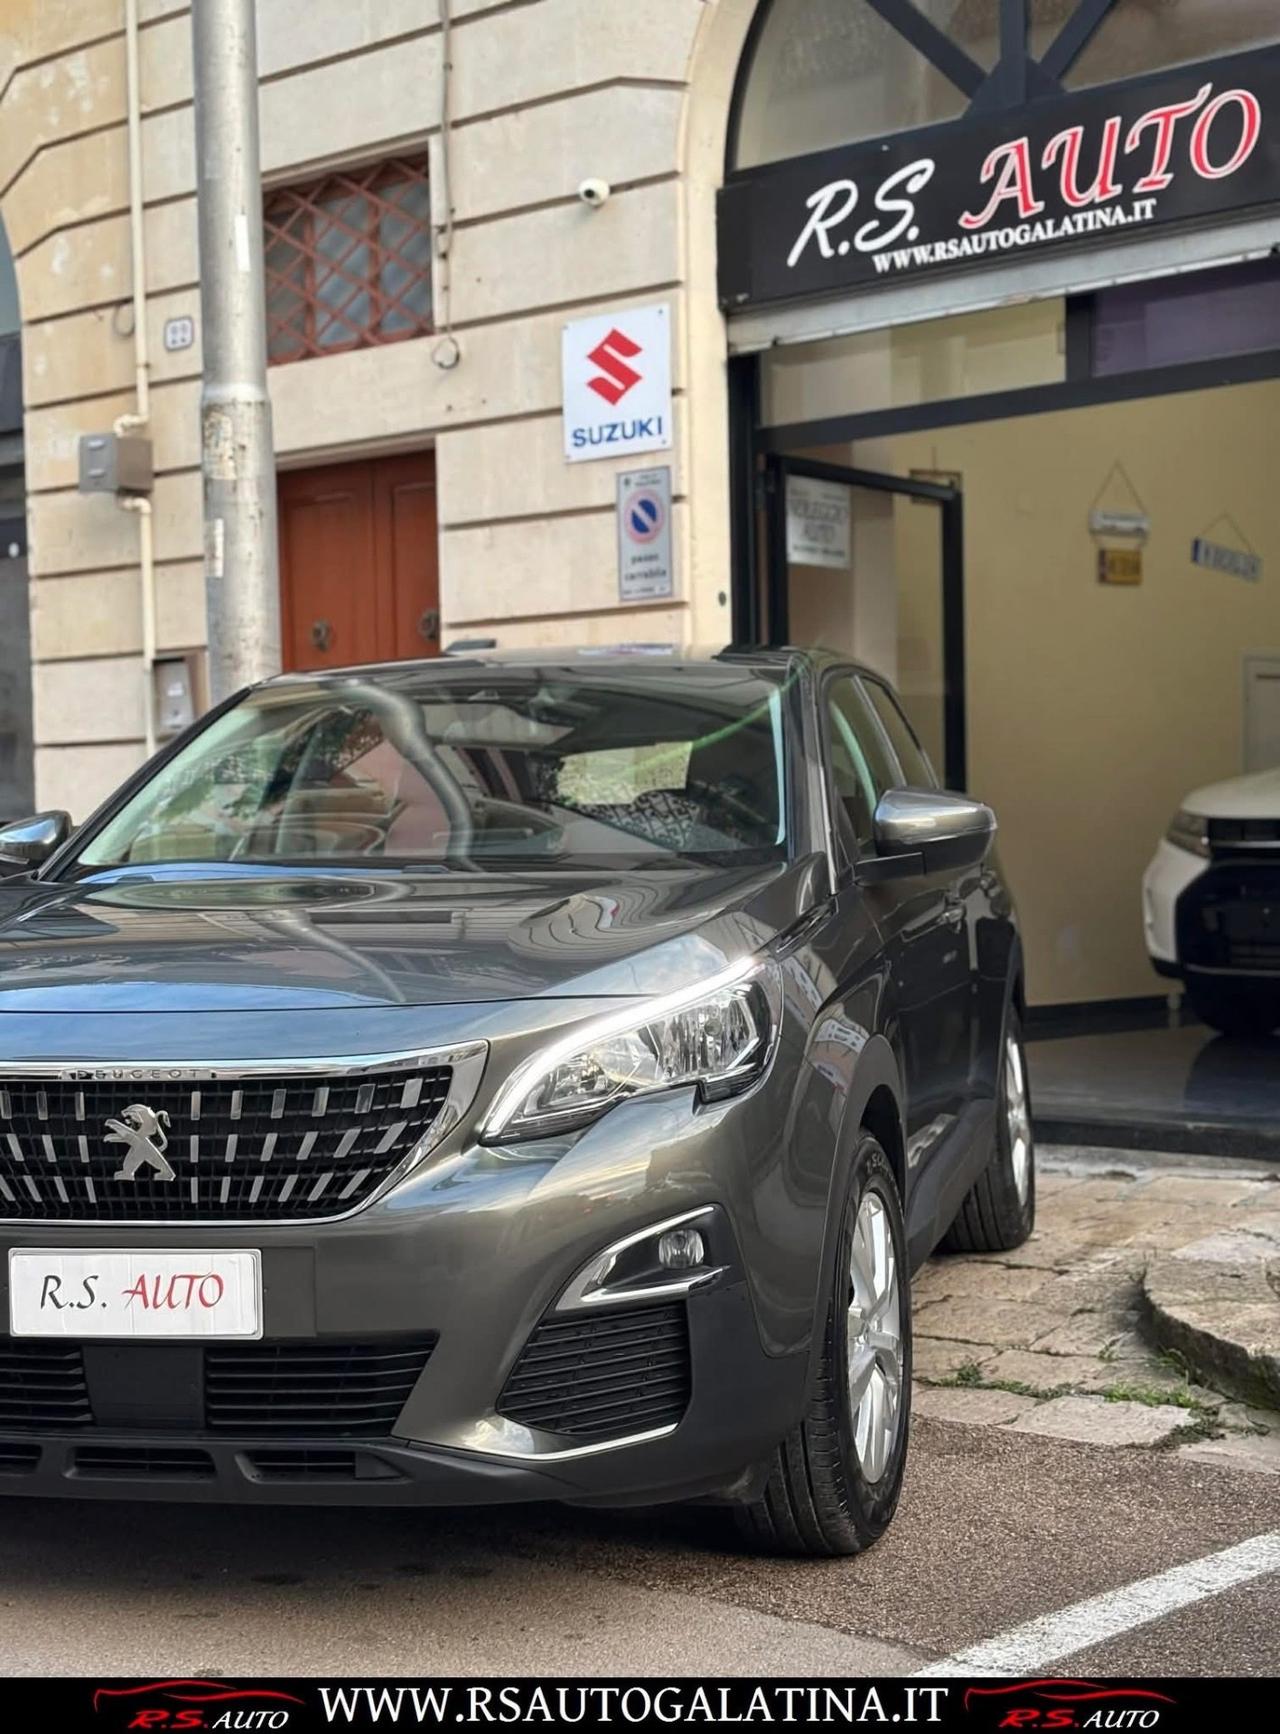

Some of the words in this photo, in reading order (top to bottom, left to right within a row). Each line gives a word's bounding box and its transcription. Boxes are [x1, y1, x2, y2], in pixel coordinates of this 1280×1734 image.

[787, 157, 935, 267] R.S.
[959, 83, 1262, 229] AUTO
[872, 198, 1157, 273] WWW.RSAUTOGALATINA.IT
[572, 416, 663, 448] SUZUKI
[76, 1069, 202, 1080] PEUGEOT
[40, 1274, 107, 1310] R.S.
[123, 1273, 224, 1310] AUTO
